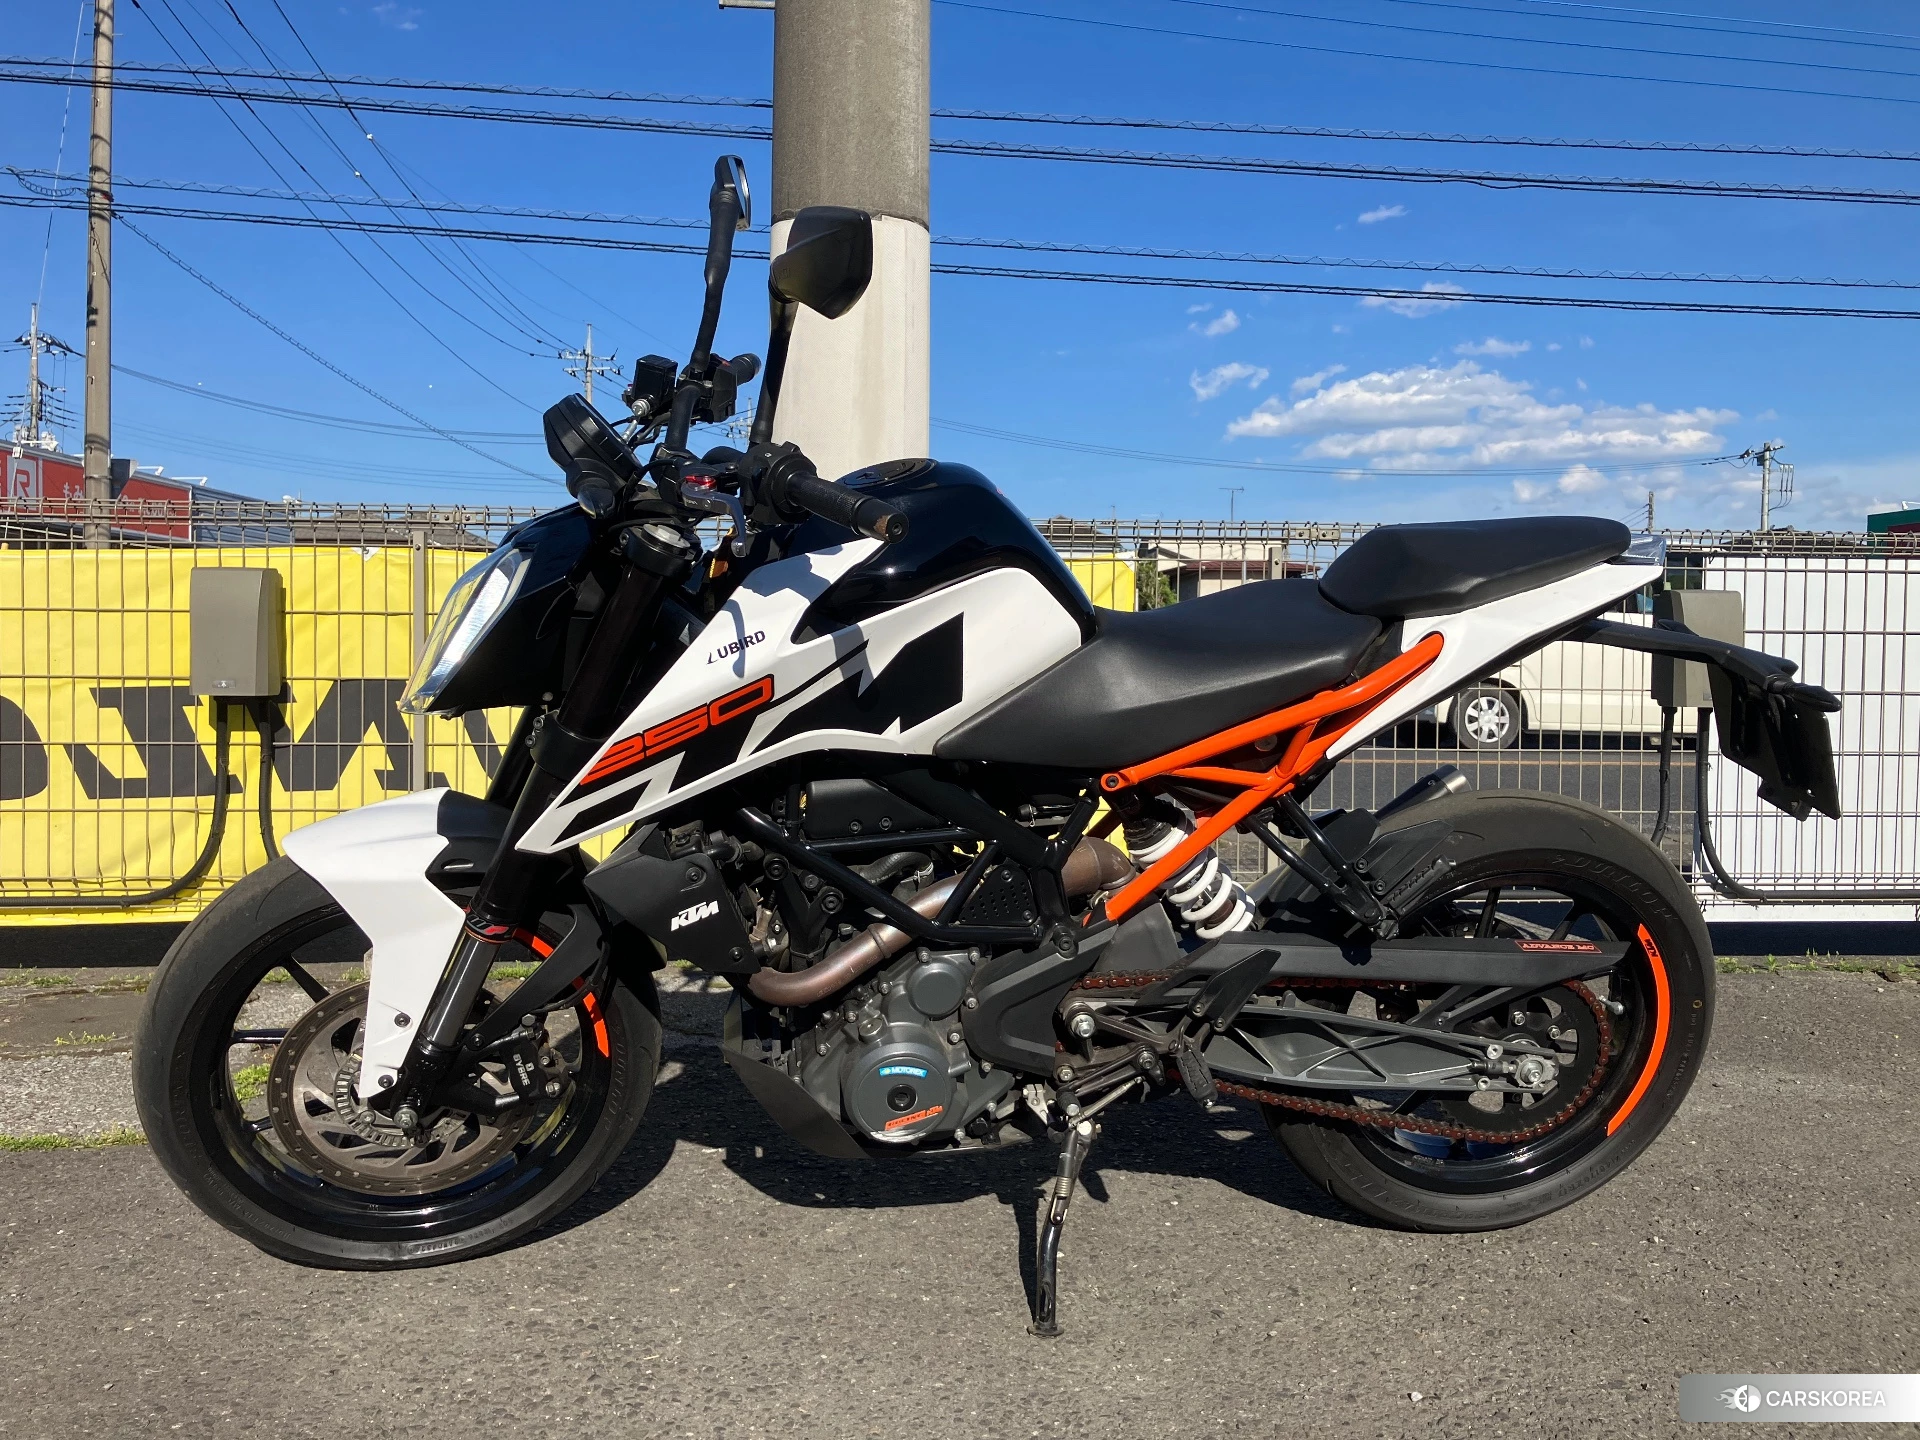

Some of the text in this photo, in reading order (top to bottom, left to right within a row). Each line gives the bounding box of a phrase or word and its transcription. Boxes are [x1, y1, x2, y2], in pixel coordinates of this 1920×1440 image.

[580, 676, 773, 786] 250
[671, 900, 720, 932] KTM
[890, 1066, 925, 1078] MOTOREX
